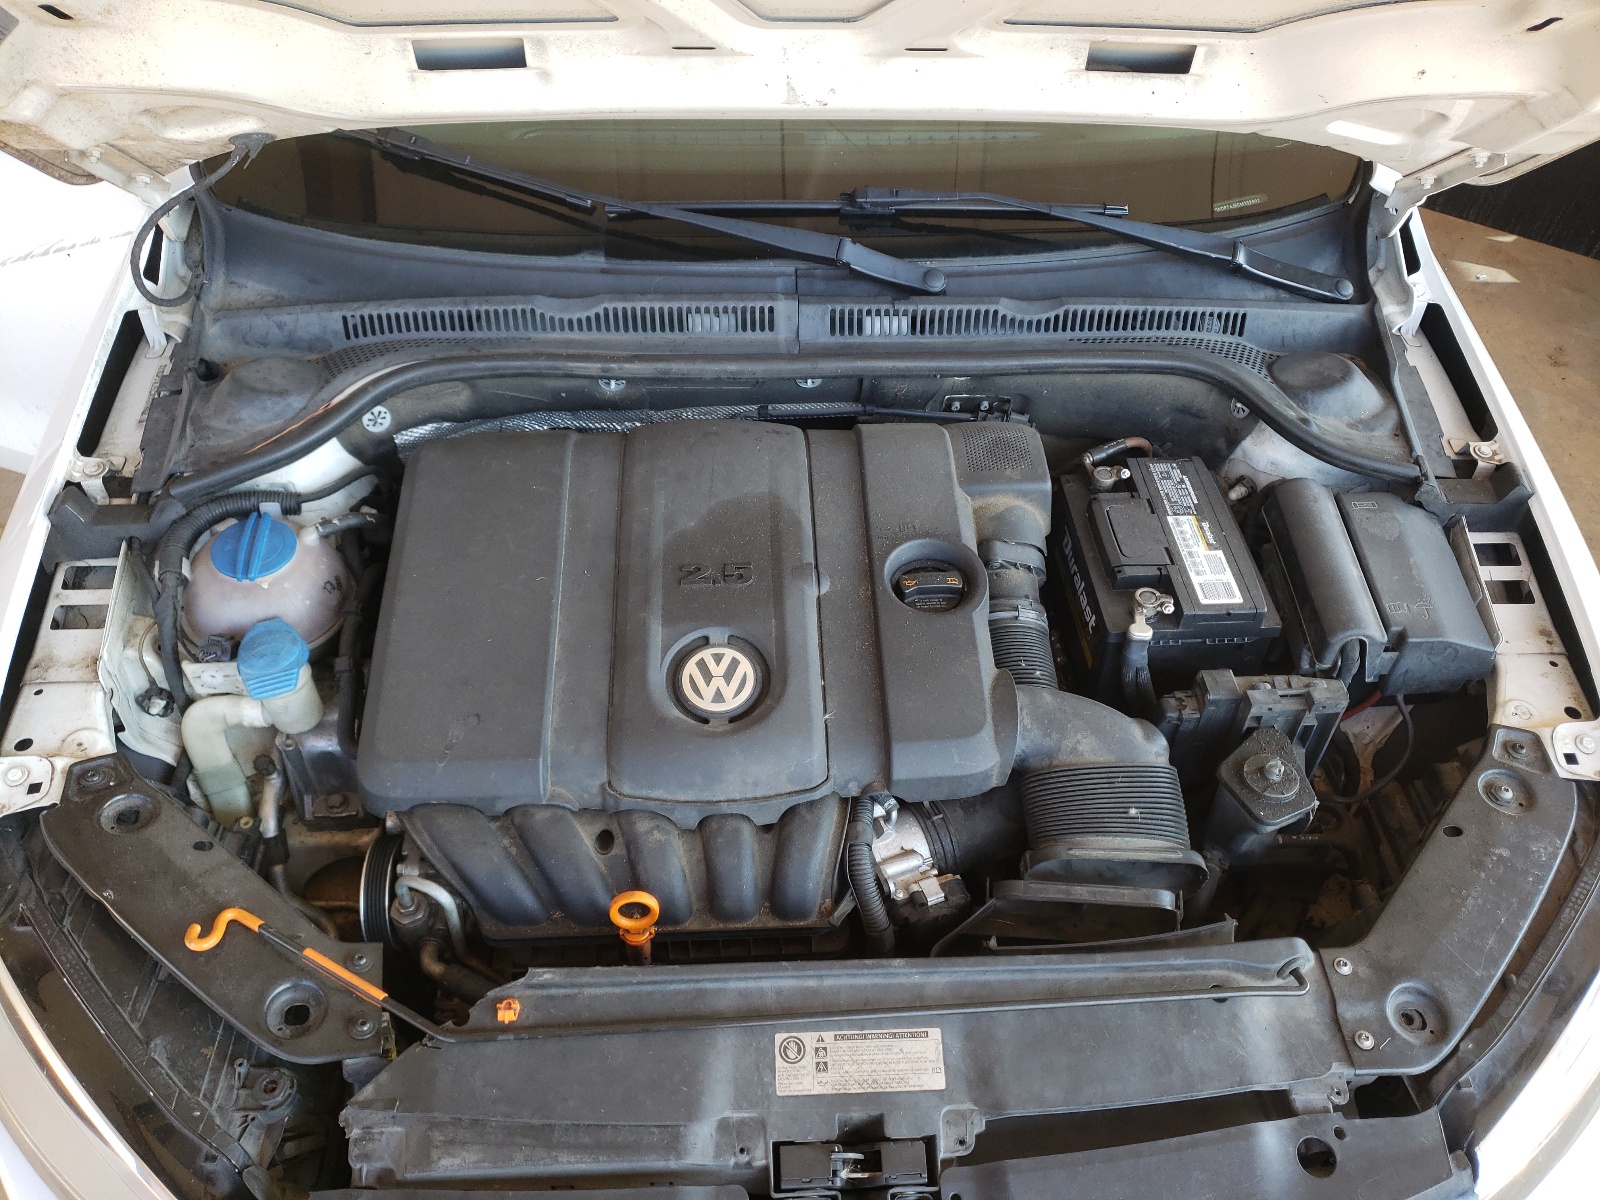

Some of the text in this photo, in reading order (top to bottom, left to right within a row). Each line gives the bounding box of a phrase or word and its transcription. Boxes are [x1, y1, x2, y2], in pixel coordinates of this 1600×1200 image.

[679, 562, 755, 588] 2.5
[1062, 525, 1096, 634] Duralast
[682, 647, 755, 712] VW
